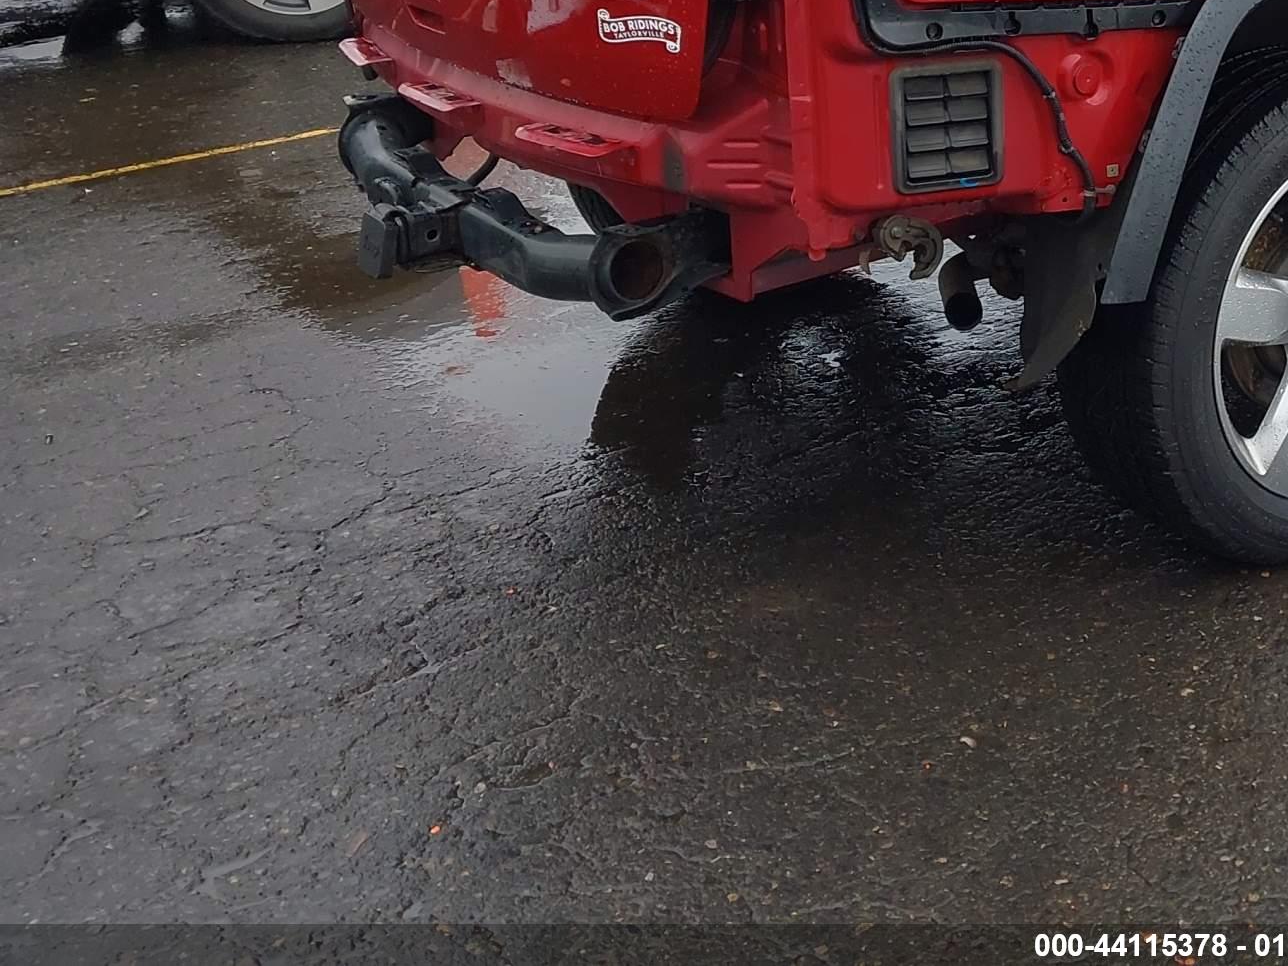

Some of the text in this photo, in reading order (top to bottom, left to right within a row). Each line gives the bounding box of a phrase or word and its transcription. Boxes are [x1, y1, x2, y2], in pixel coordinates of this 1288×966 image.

[603, 19, 675, 35] BOB RIDINGS
[613, 30, 664, 39] TAYLORVILLE
